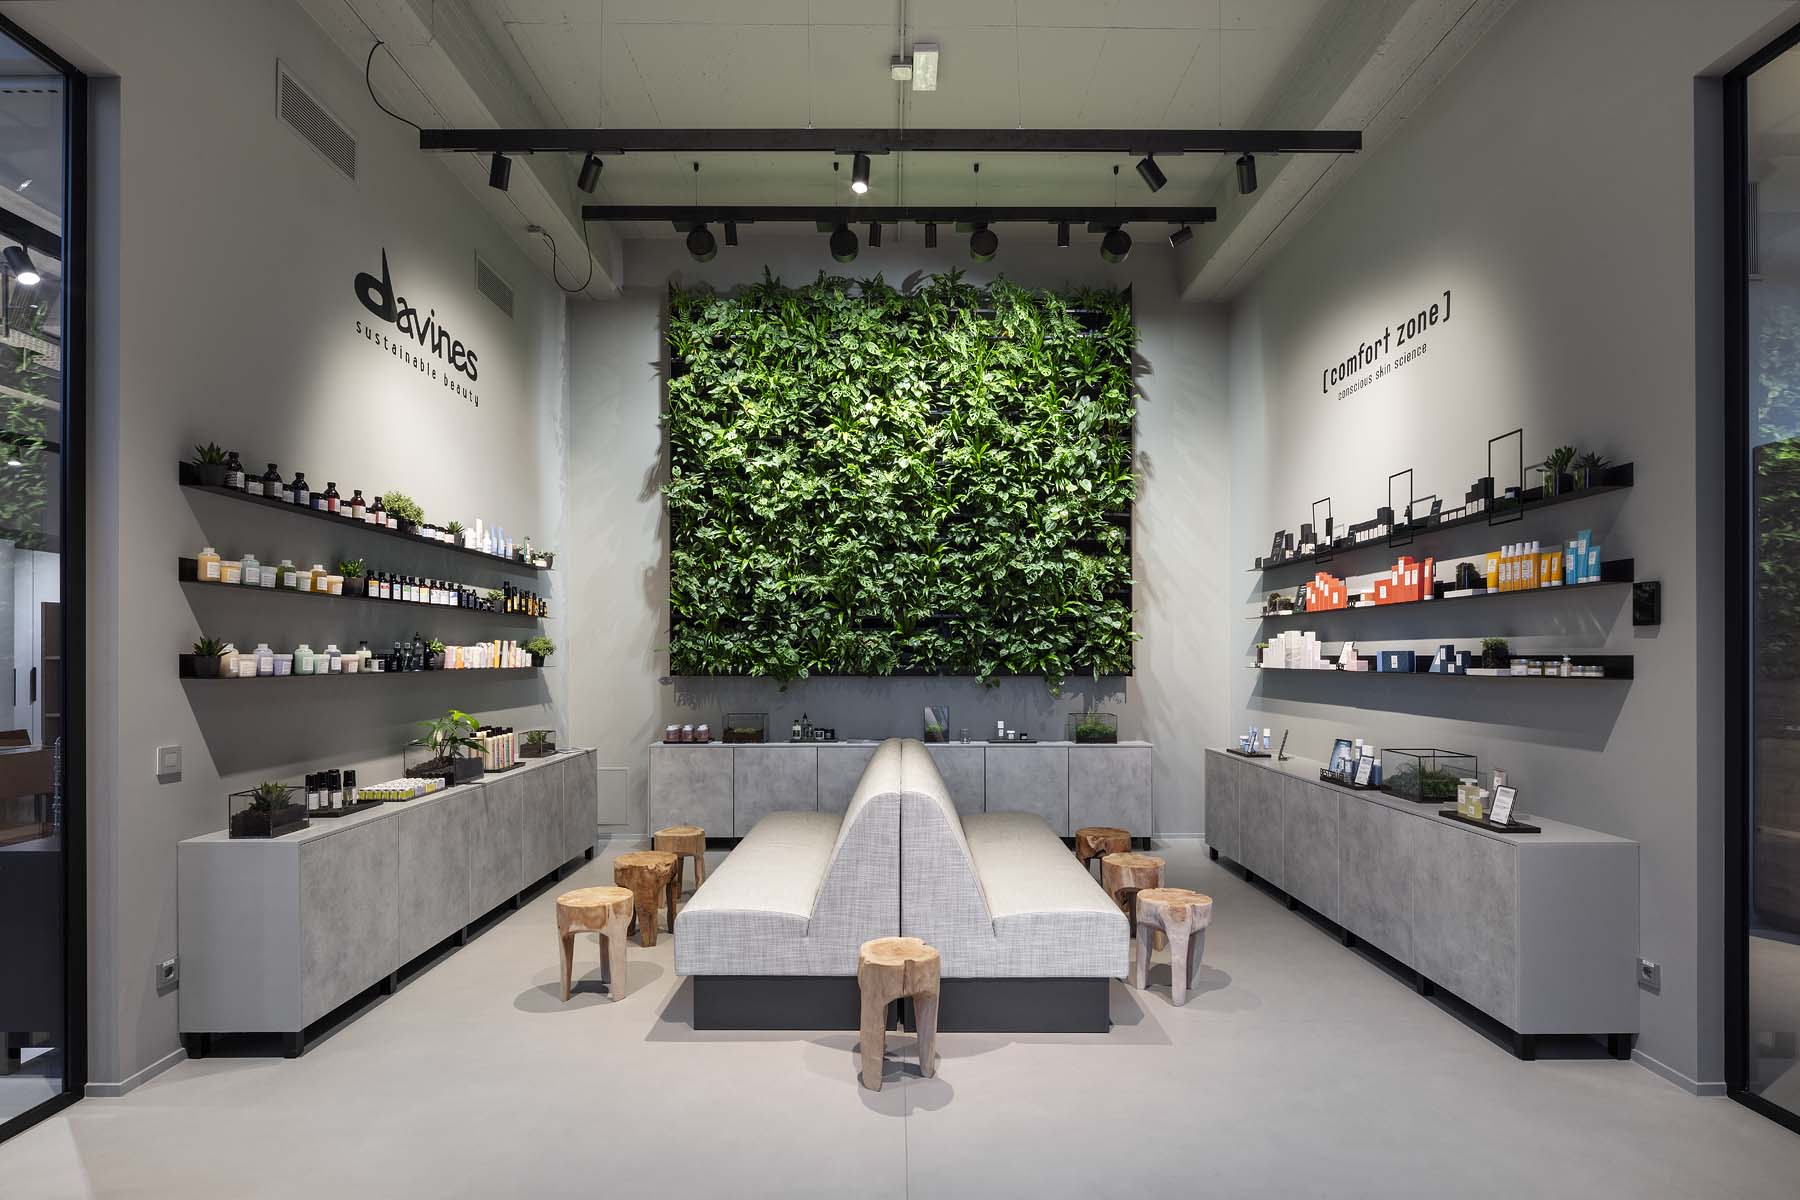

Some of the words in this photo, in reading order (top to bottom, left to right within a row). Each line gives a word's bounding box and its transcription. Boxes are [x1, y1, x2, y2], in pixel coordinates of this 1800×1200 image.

[354, 247, 479, 382] davines
[356, 320, 437, 380] sustainable
[443, 372, 479, 408] beauty
[1338, 373, 1373, 401] conscious
[1375, 364, 1391, 381] skin
[1394, 343, 1427, 369] science
